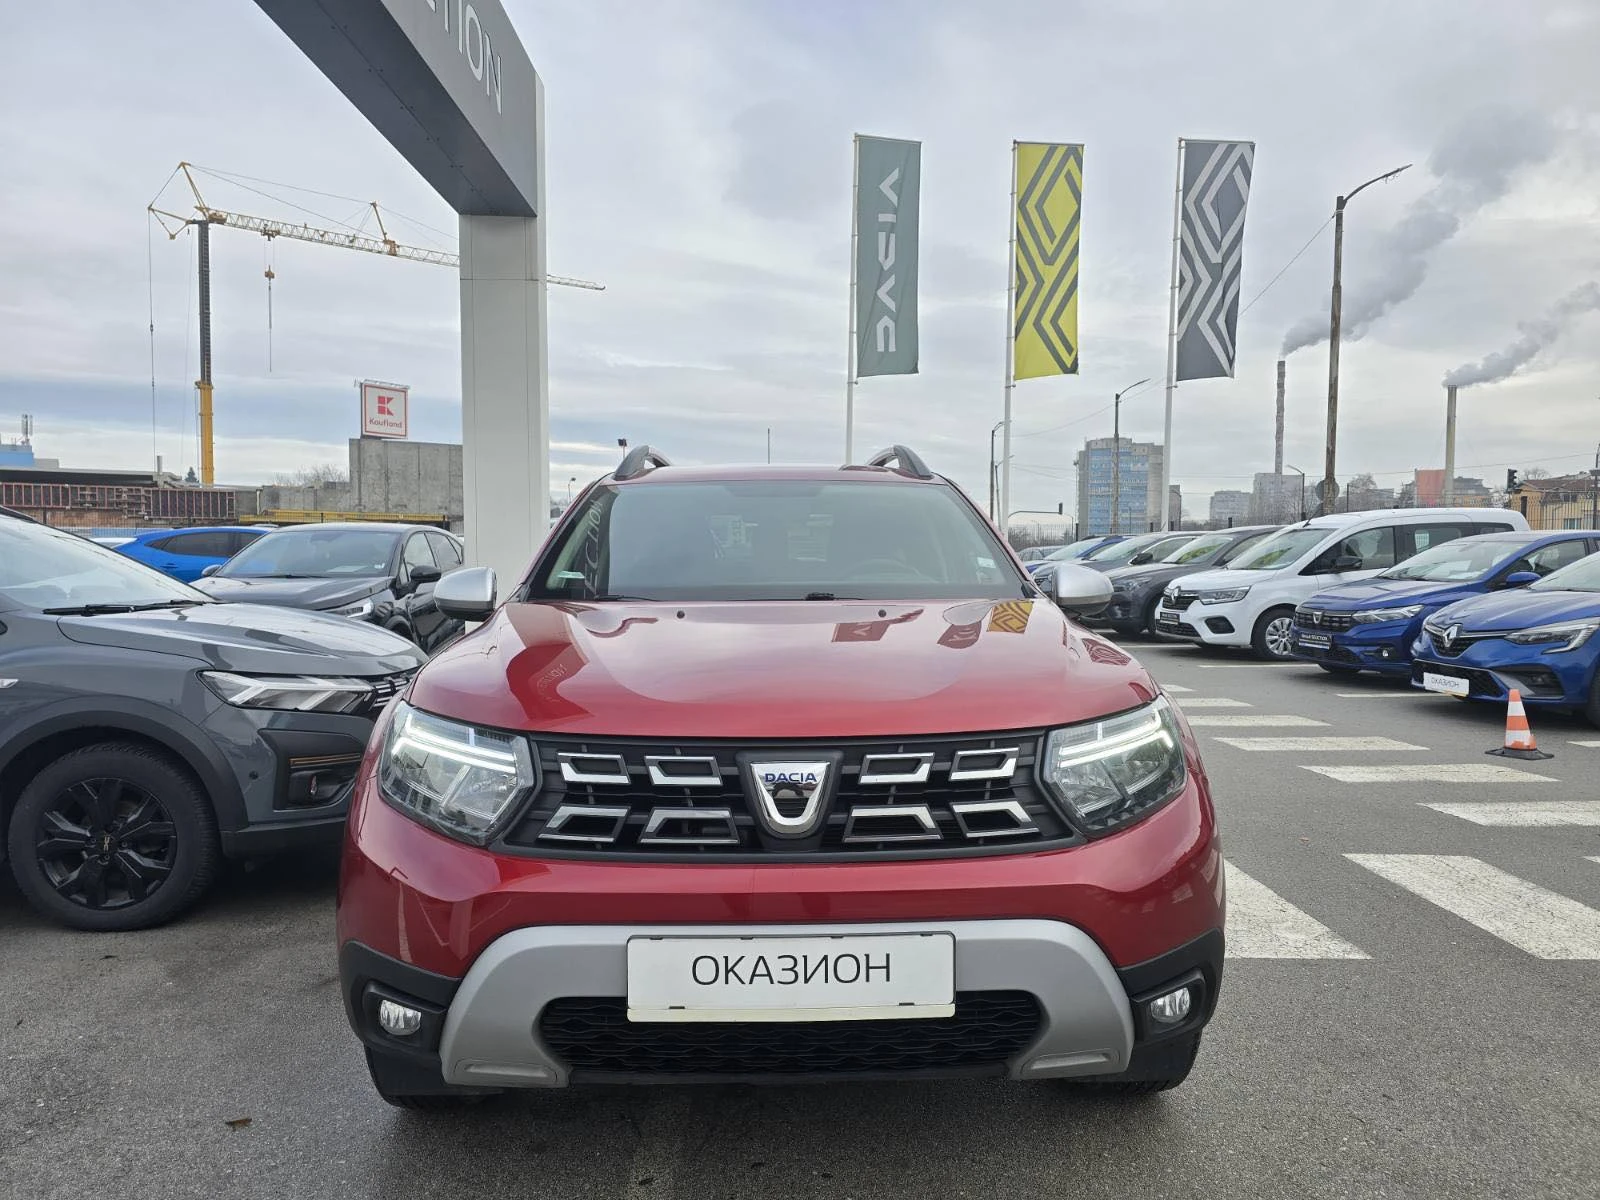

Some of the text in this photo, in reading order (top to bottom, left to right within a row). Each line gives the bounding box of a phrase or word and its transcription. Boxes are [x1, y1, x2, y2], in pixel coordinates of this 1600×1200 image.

[369, 417, 403, 429] Kaufland
[764, 772, 817, 783] DACIA
[691, 952, 892, 986] ОКАЗИОН
